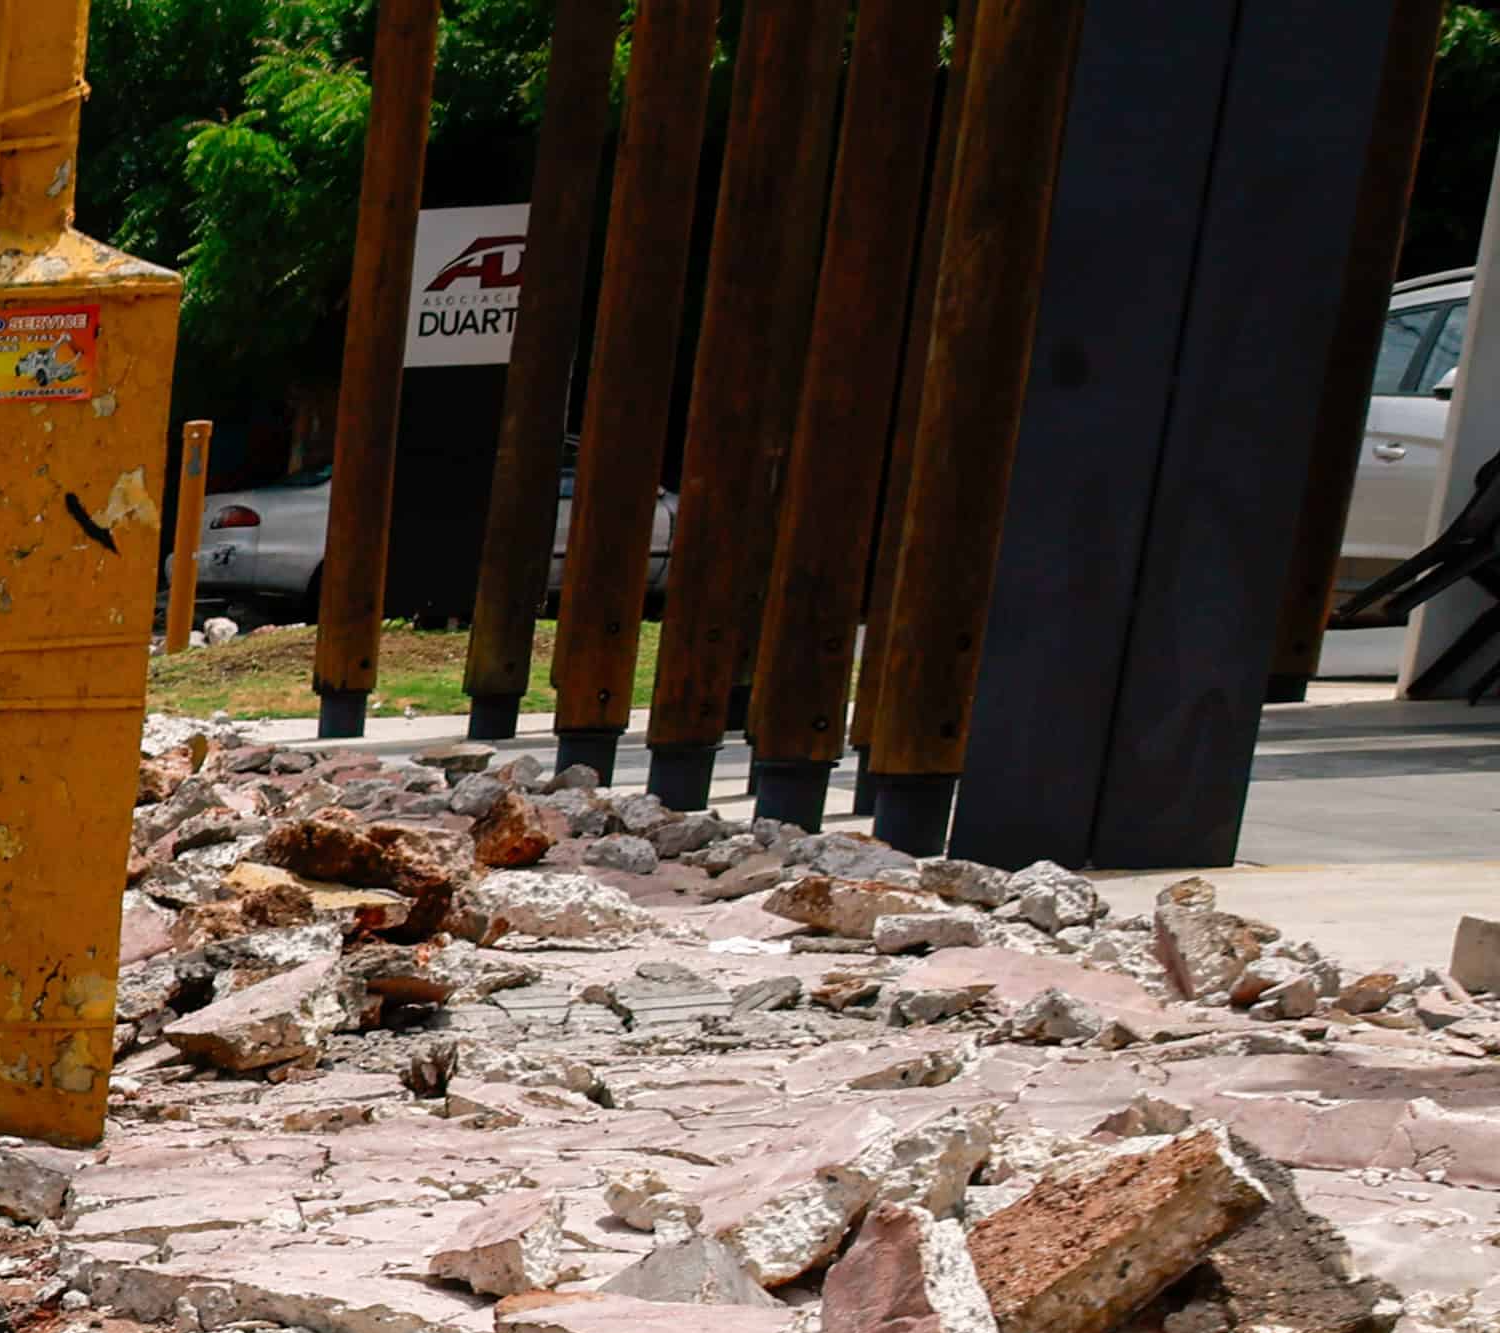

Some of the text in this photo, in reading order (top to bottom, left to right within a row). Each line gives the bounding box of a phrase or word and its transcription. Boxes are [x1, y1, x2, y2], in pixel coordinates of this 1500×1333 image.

[423, 294, 514, 306] ASOCIACI
[9, 314, 87, 330] SERVICE
[419, 308, 519, 337] DUART
